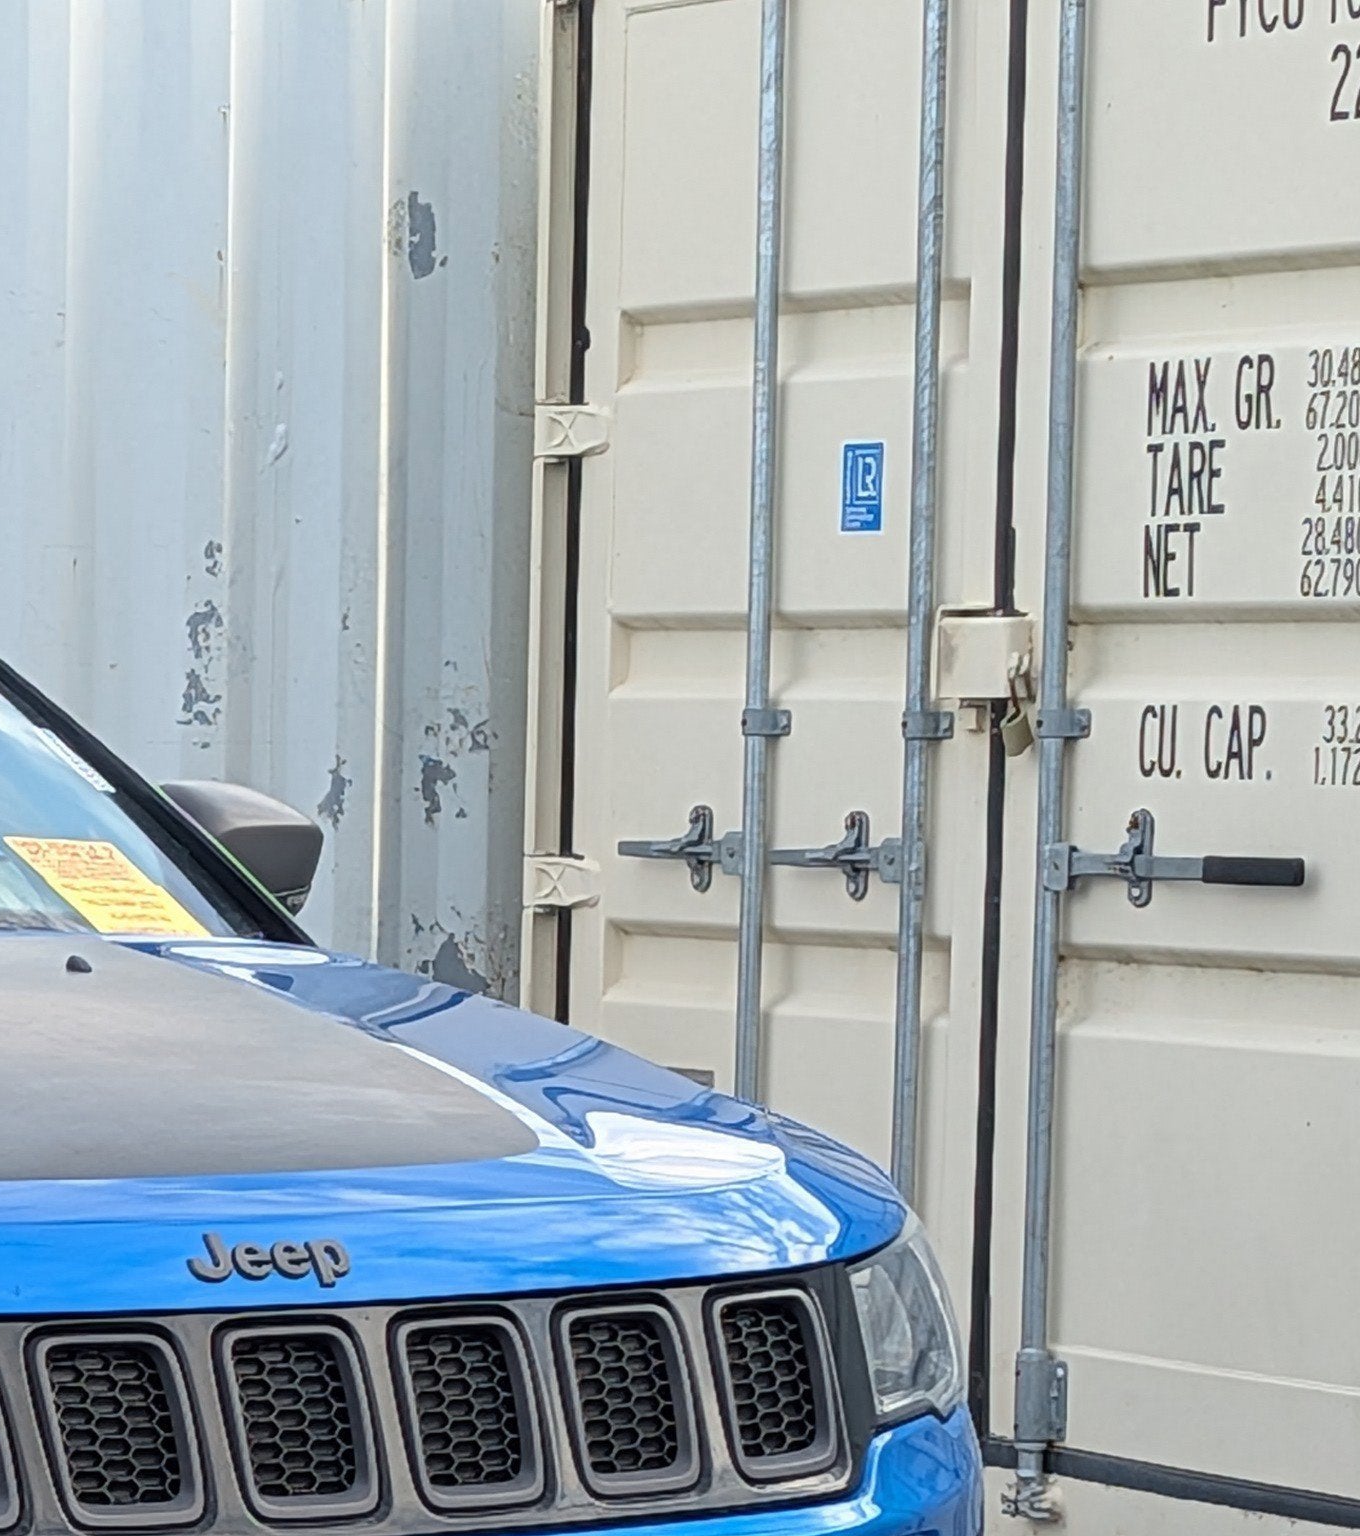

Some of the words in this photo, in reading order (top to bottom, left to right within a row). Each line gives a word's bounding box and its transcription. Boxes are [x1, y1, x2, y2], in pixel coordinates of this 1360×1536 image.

[1147, 357, 1216, 436] MAX.
[1235, 353, 1281, 430] GR.
[1147, 439, 1226, 517] TARE
[1143, 522, 1201, 598] NET
[1139, 704, 1182, 779] CU.
[1204, 704, 1272, 781] CAP.
[186, 1232, 351, 1288] Jeep
